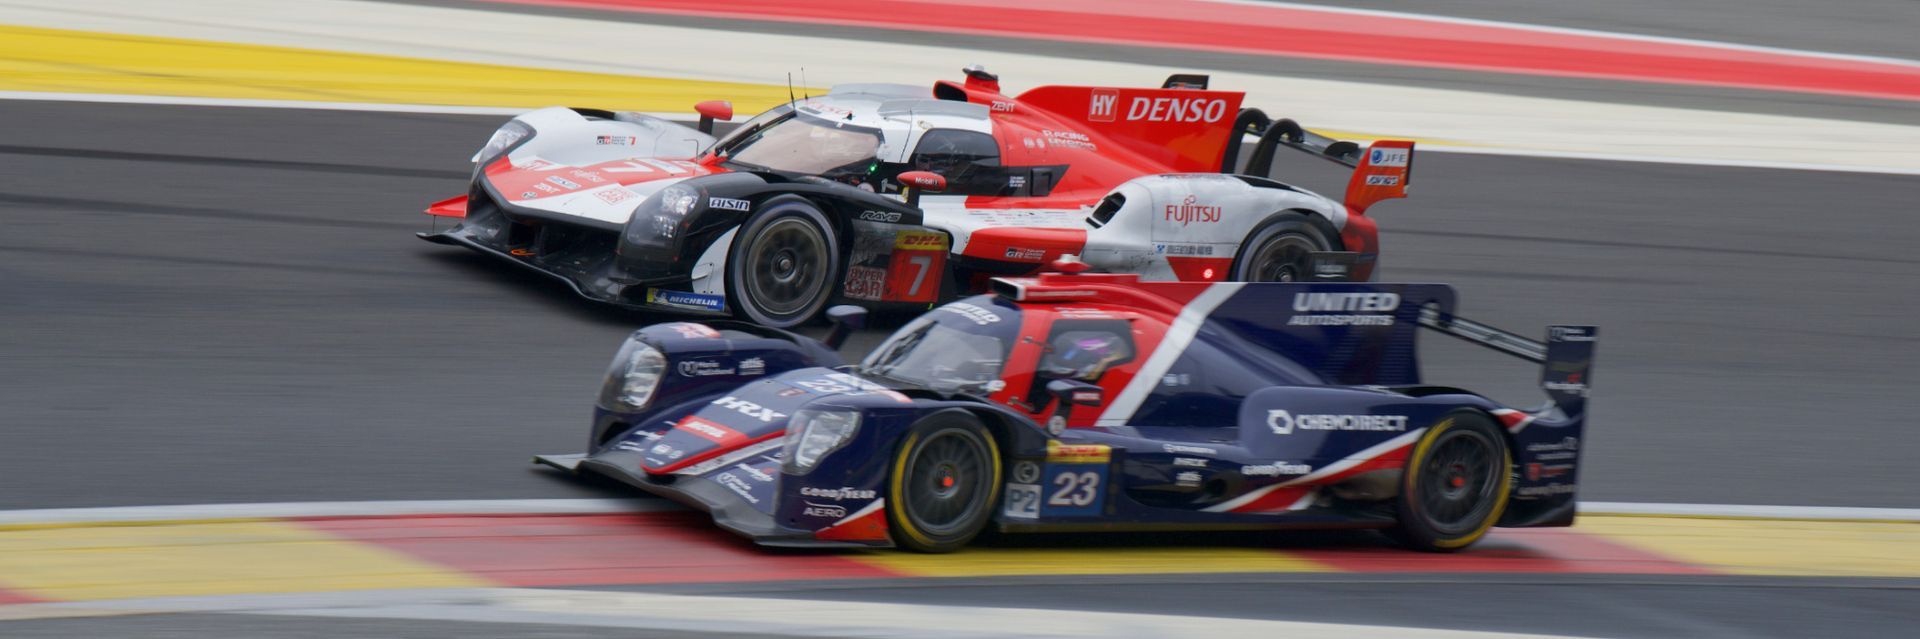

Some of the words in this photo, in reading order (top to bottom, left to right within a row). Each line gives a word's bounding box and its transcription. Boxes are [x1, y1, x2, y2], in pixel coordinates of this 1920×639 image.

[992, 100, 1015, 112] ZENT
[1091, 95, 1116, 116] HY
[1126, 97, 1226, 122] DENSO
[1384, 153, 1407, 163] JFE
[860, 210, 901, 222] RAYS
[1165, 203, 1221, 226] FUJITSU
[904, 235, 942, 246] DHL
[850, 268, 885, 281] HYPER
[908, 255, 932, 296] 7
[846, 281, 883, 297] CAR
[670, 296, 718, 306] MICHELIN
[1293, 292, 1399, 311] UNITED
[711, 396, 787, 422] HRX
[801, 486, 877, 501] GOODYEAR
[1048, 471, 1099, 506] 23
[1008, 489, 1036, 513] P2
[803, 507, 846, 518] AERO
